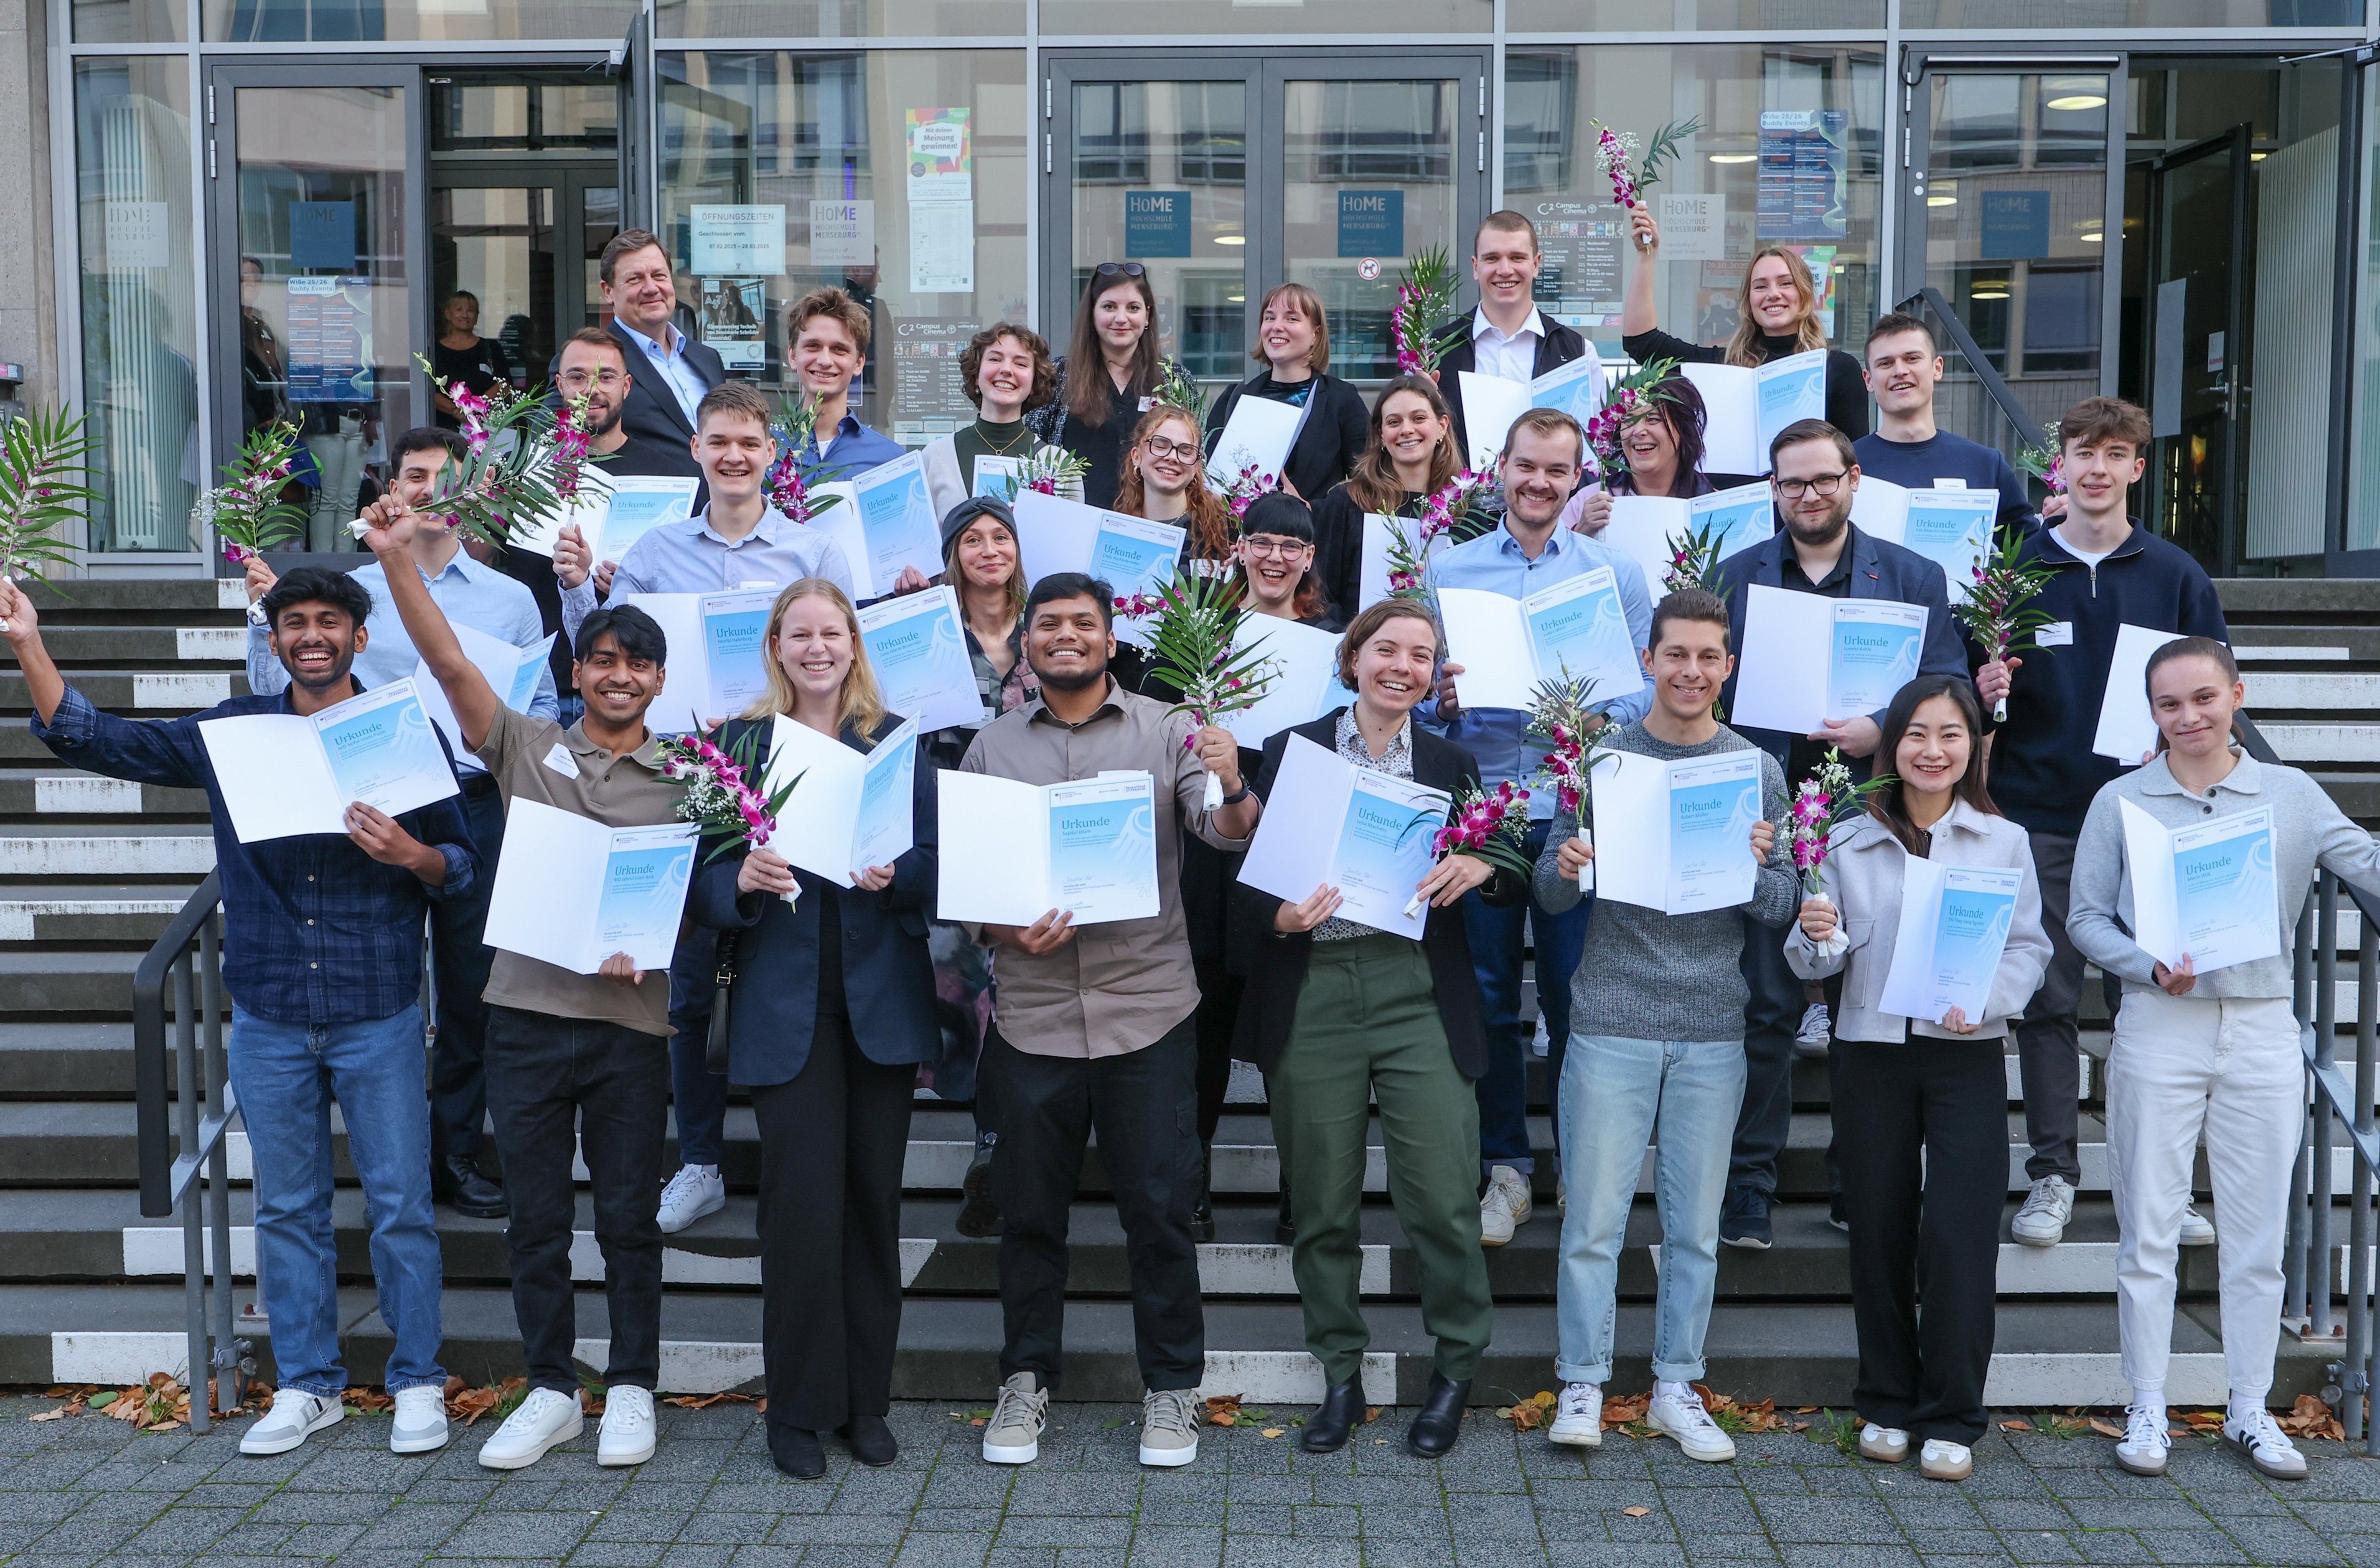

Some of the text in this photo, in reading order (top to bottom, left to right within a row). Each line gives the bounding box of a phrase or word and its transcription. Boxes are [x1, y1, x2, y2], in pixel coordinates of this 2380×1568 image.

[921, 143, 957, 151] gewinnen!
[702, 212, 774, 220] ÖFFNUNGSZEITEN
[1765, 383, 1794, 398] Urkunde
[617, 500, 655, 509] Urkunde
[868, 492, 898, 511] Urkunde
[1700, 517, 1737, 530] Ukunde
[1916, 519, 1956, 528] Urkunde
[1104, 543, 1141, 561] Urkunde
[1541, 611, 1582, 632] Urkunde
[716, 625, 757, 637] Urkunde
[877, 631, 919, 652] Urkunde
[1844, 636, 1888, 647] Urkunde
[335, 723, 382, 746] Urkunde
[868, 766, 892, 791] Urkunde
[1680, 799, 1722, 814] Urkunde
[1062, 817, 1110, 830] Urkunde
[1356, 819, 1367, 827] Lena
[1358, 807, 1402, 830] Urkunde
[614, 863, 654, 876] Urkunde
[2186, 857, 2231, 875] Urkunde
[1949, 905, 1984, 919] Urkunde
